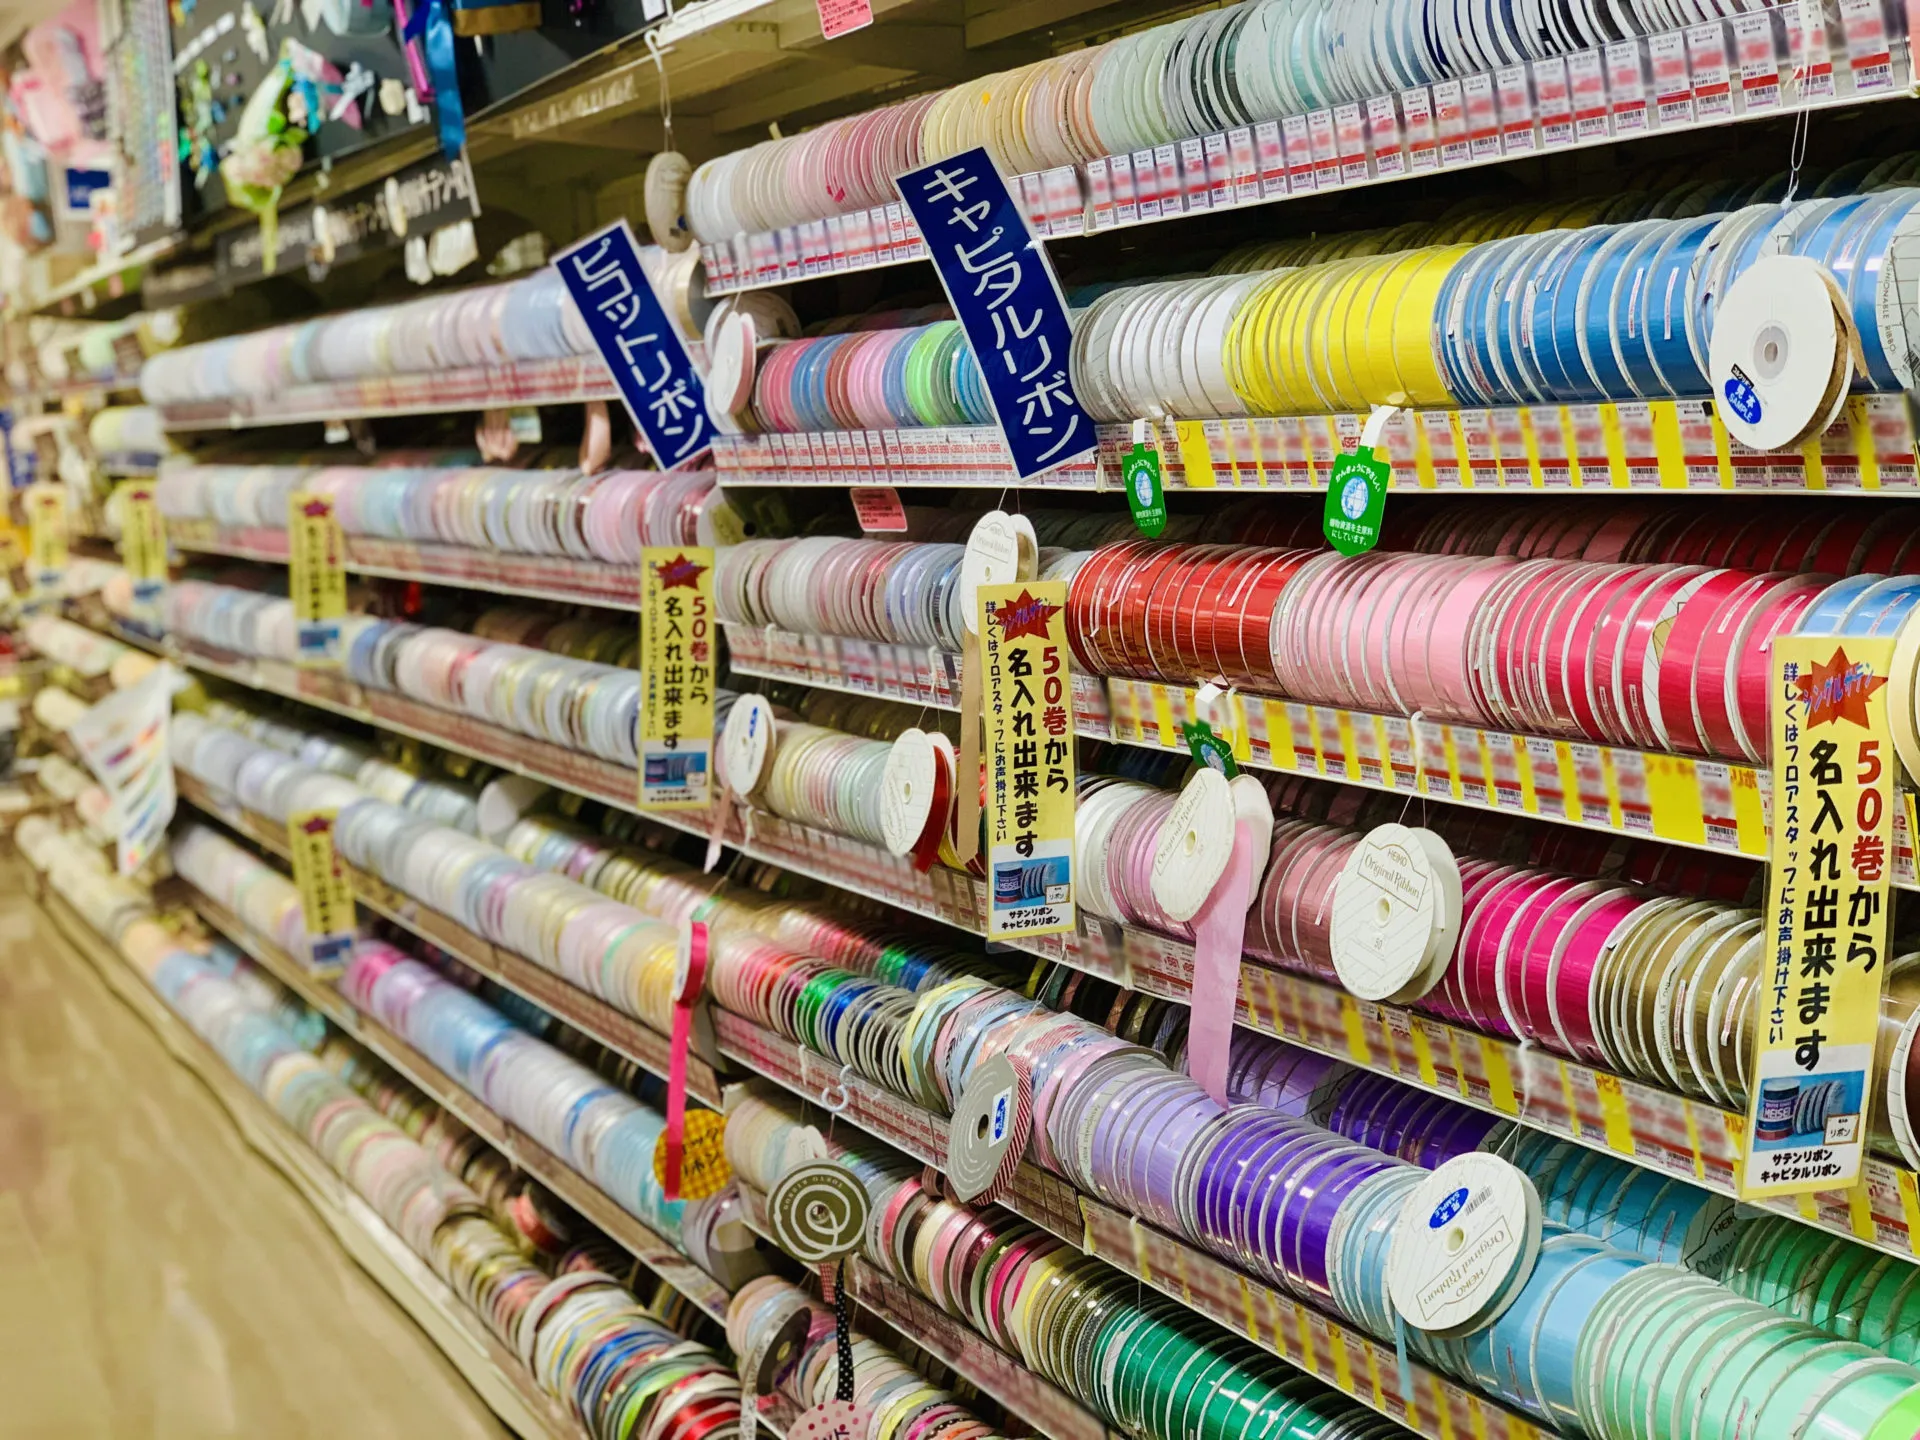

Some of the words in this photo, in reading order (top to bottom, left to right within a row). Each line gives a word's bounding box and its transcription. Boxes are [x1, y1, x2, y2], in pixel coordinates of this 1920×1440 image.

[922, 167, 1079, 463] キャピタルリボン
[571, 237, 704, 459] ピコットリボン
[1729, 393, 1753, 422] SAMPLE
[1802, 661, 1875, 716] シングルサテン
[1042, 646, 1069, 793] 50巻から
[1007, 647, 1039, 858] 名入れ出来ます
[1769, 662, 1799, 1044] 詳しくはフロアスタッフにお声掛け下さい
[1847, 739, 1885, 973] 50巻から
[1364, 853, 1397, 883] Original
[1393, 871, 1420, 898] Ribbon
[1009, 907, 1053, 919] サテンリボン
[1795, 739, 1844, 1072] 名入れ出来ます
[1830, 1127, 1851, 1138] リボン
[1761, 1164, 1842, 1184] キャピタルリボン
[1773, 1149, 1833, 1166] サテンリボン
[1435, 1191, 1460, 1218] SAMPLE
[1463, 1229, 1505, 1273] Original
[1423, 1268, 1464, 1305] Ribbon
[1456, 1268, 1485, 1298] HEIKO
